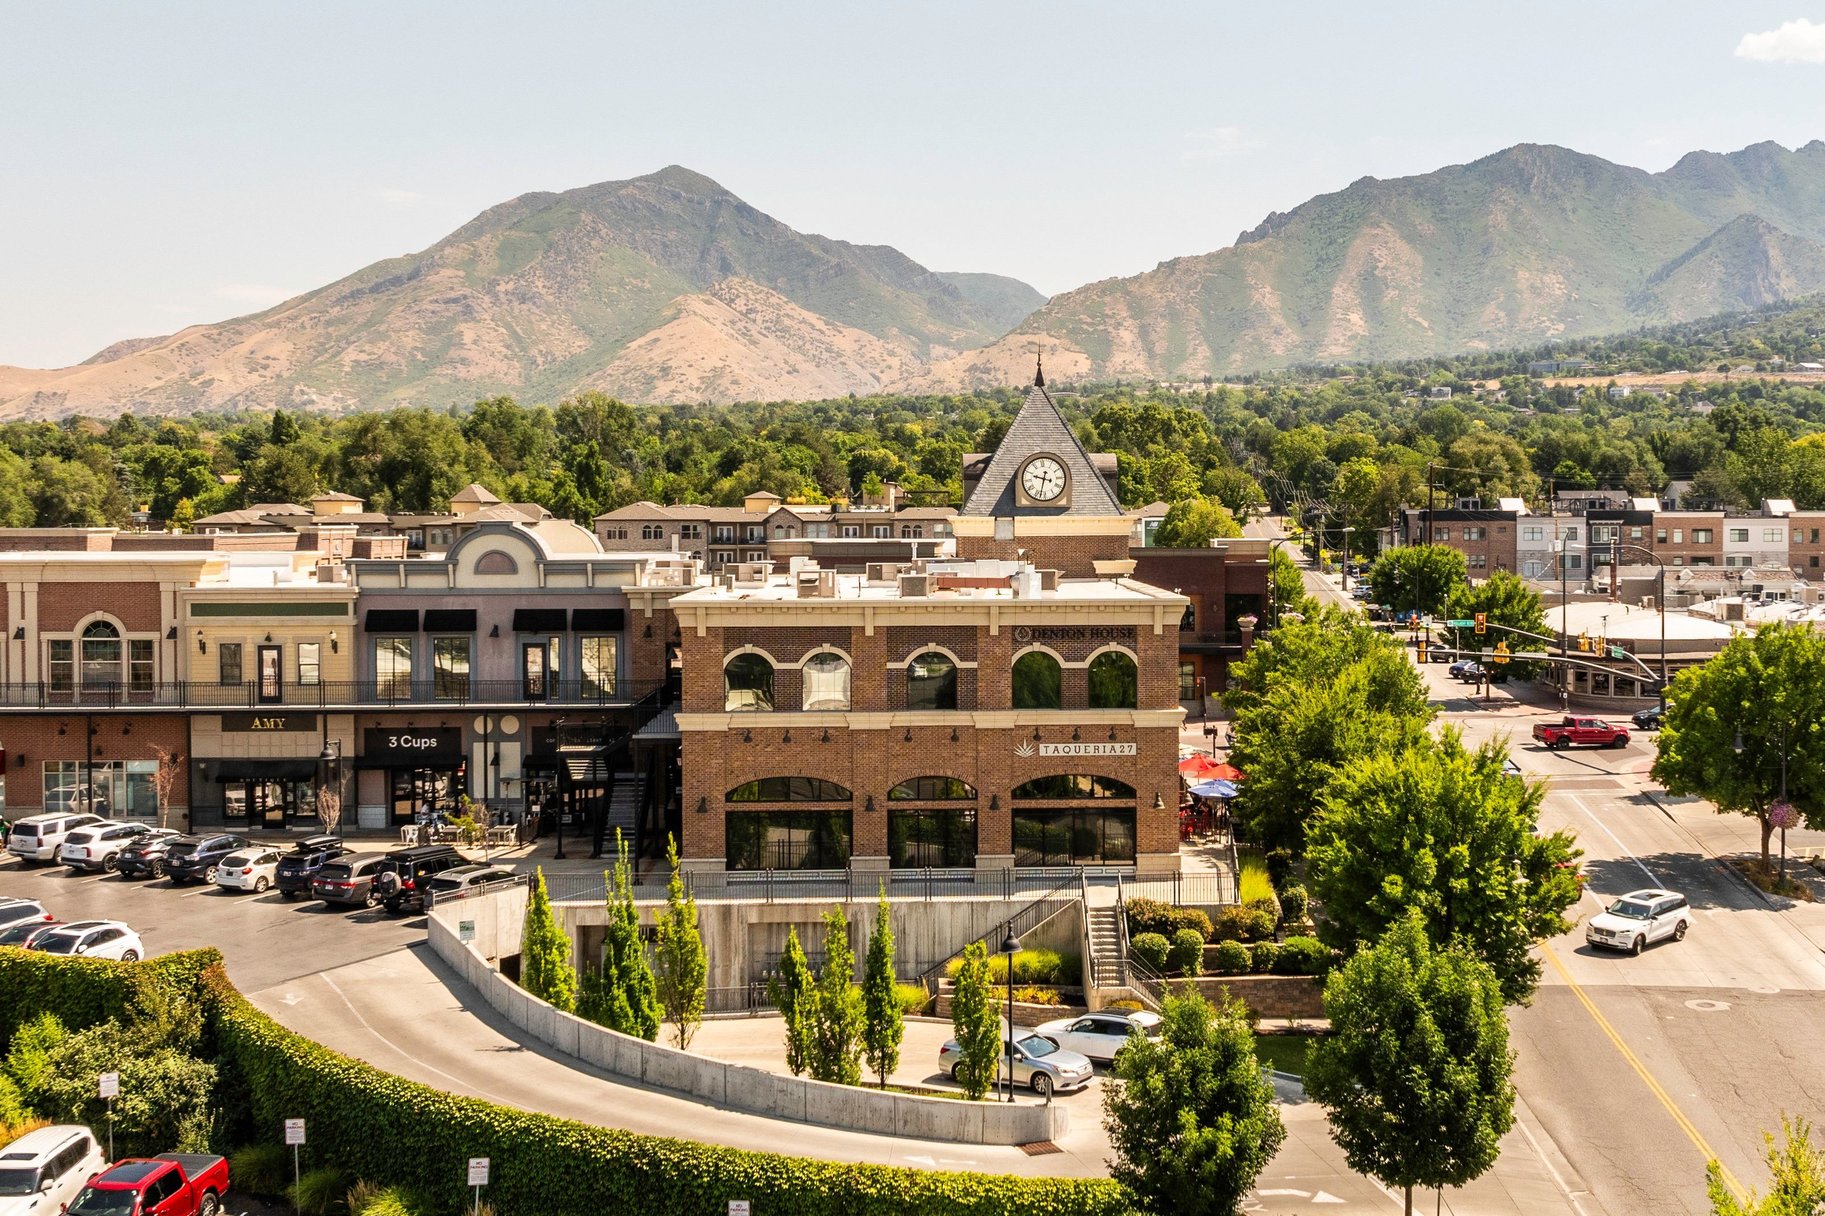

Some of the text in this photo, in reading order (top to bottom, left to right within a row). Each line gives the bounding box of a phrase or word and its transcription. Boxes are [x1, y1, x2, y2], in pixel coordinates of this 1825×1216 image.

[1032, 628, 1135, 639] DENTON HOUSE
[251, 717, 286, 729] AMY
[388, 735, 438, 750] 3 Cups
[1043, 744, 1134, 755] TAQUERIA27
